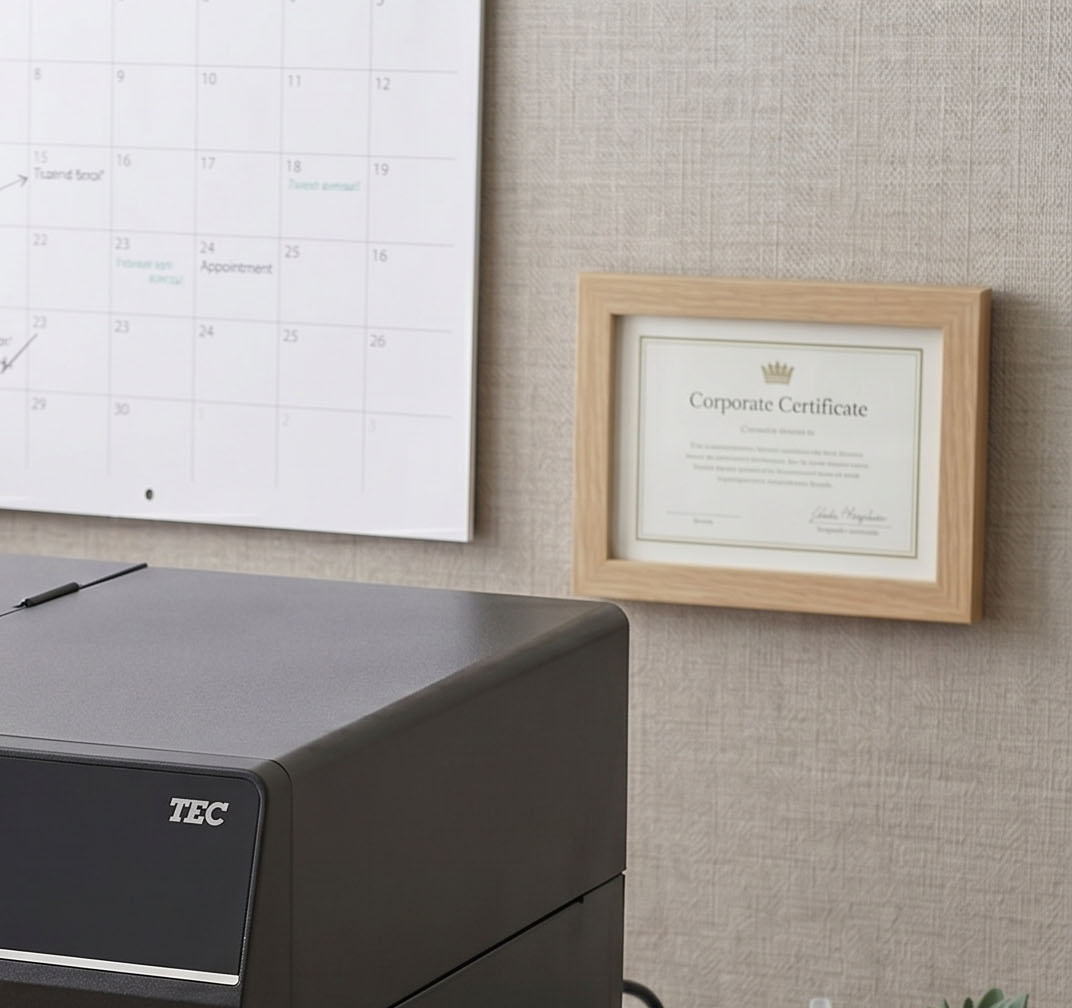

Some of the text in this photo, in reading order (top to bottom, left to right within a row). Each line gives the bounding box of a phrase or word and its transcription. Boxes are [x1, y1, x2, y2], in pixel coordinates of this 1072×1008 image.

[33, 66, 43, 81] 8
[116, 69, 126, 83] 9
[202, 72, 218, 86] 10
[288, 75, 302, 88] 11
[376, 77, 391, 91] 12
[33, 151, 48, 164] 15
[116, 153, 132, 167] 16
[201, 157, 216, 170] 17
[286, 160, 302, 173] 18
[373, 162, 390, 176] 19
[32, 234, 48, 247] 22
[115, 237, 131, 250] 23
[199, 241, 216, 254] 24
[284, 245, 301, 259] 25
[373, 249, 388, 262] 16
[200, 260, 273, 275] Appointment
[198, 324, 215, 338] 24
[283, 329, 299, 343] 25
[369, 334, 387, 348] 26
[31, 396, 47, 411] 29
[689, 391, 868, 418] Corporate Certificate
[168, 797, 230, 826] TEC
